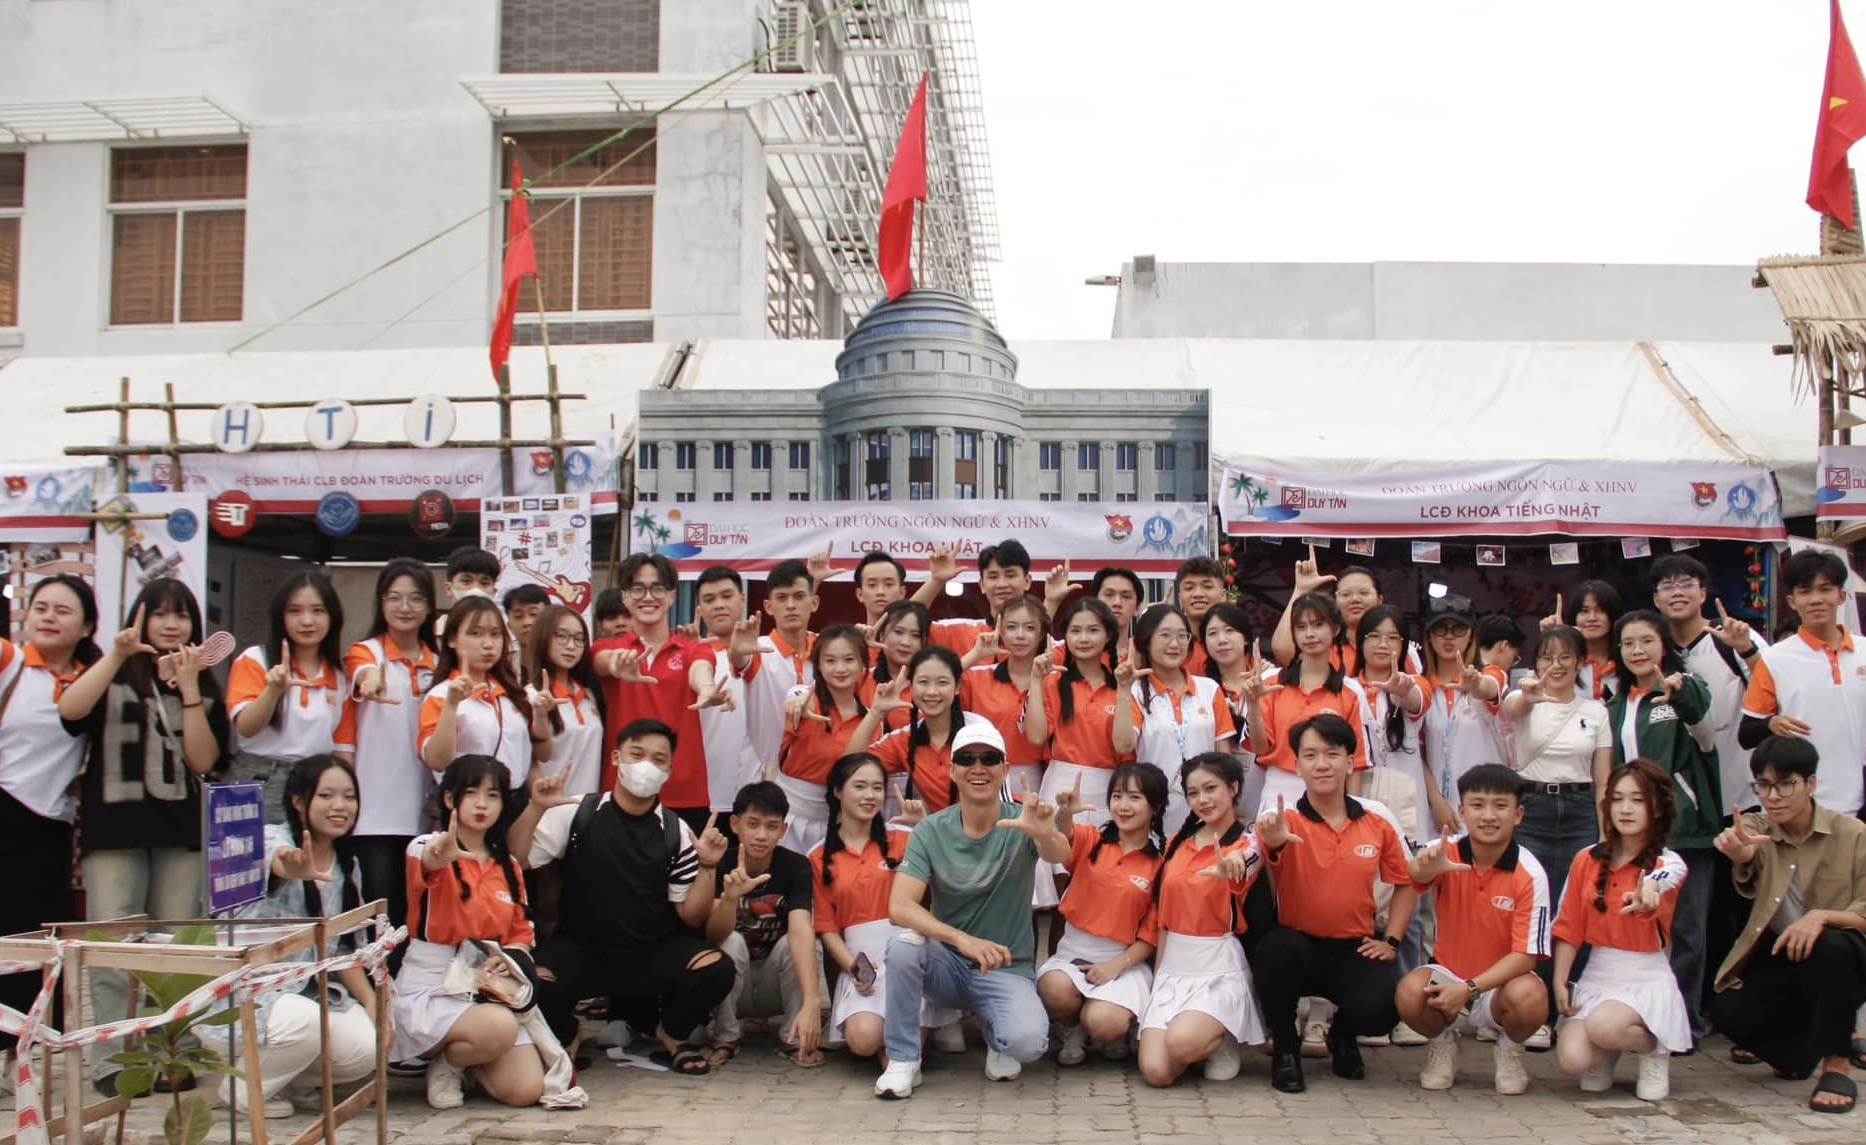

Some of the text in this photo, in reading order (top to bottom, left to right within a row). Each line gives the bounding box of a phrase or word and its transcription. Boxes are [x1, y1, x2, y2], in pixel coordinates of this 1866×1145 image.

[223, 408, 249, 445] H
[317, 406, 343, 441] T
[434, 474, 452, 485] DU
[1578, 481, 1590, 492] &
[1308, 498, 1326, 509] DUY
[1420, 500, 1601, 520] LCĐ KHOA TIẾNG NHẬT
[989, 516, 1001, 528] &
[1006, 516, 1050, 528] XHNV
[709, 534, 728, 545] DUY
[851, 539, 982, 557] LCĐ KHOA ẬT
